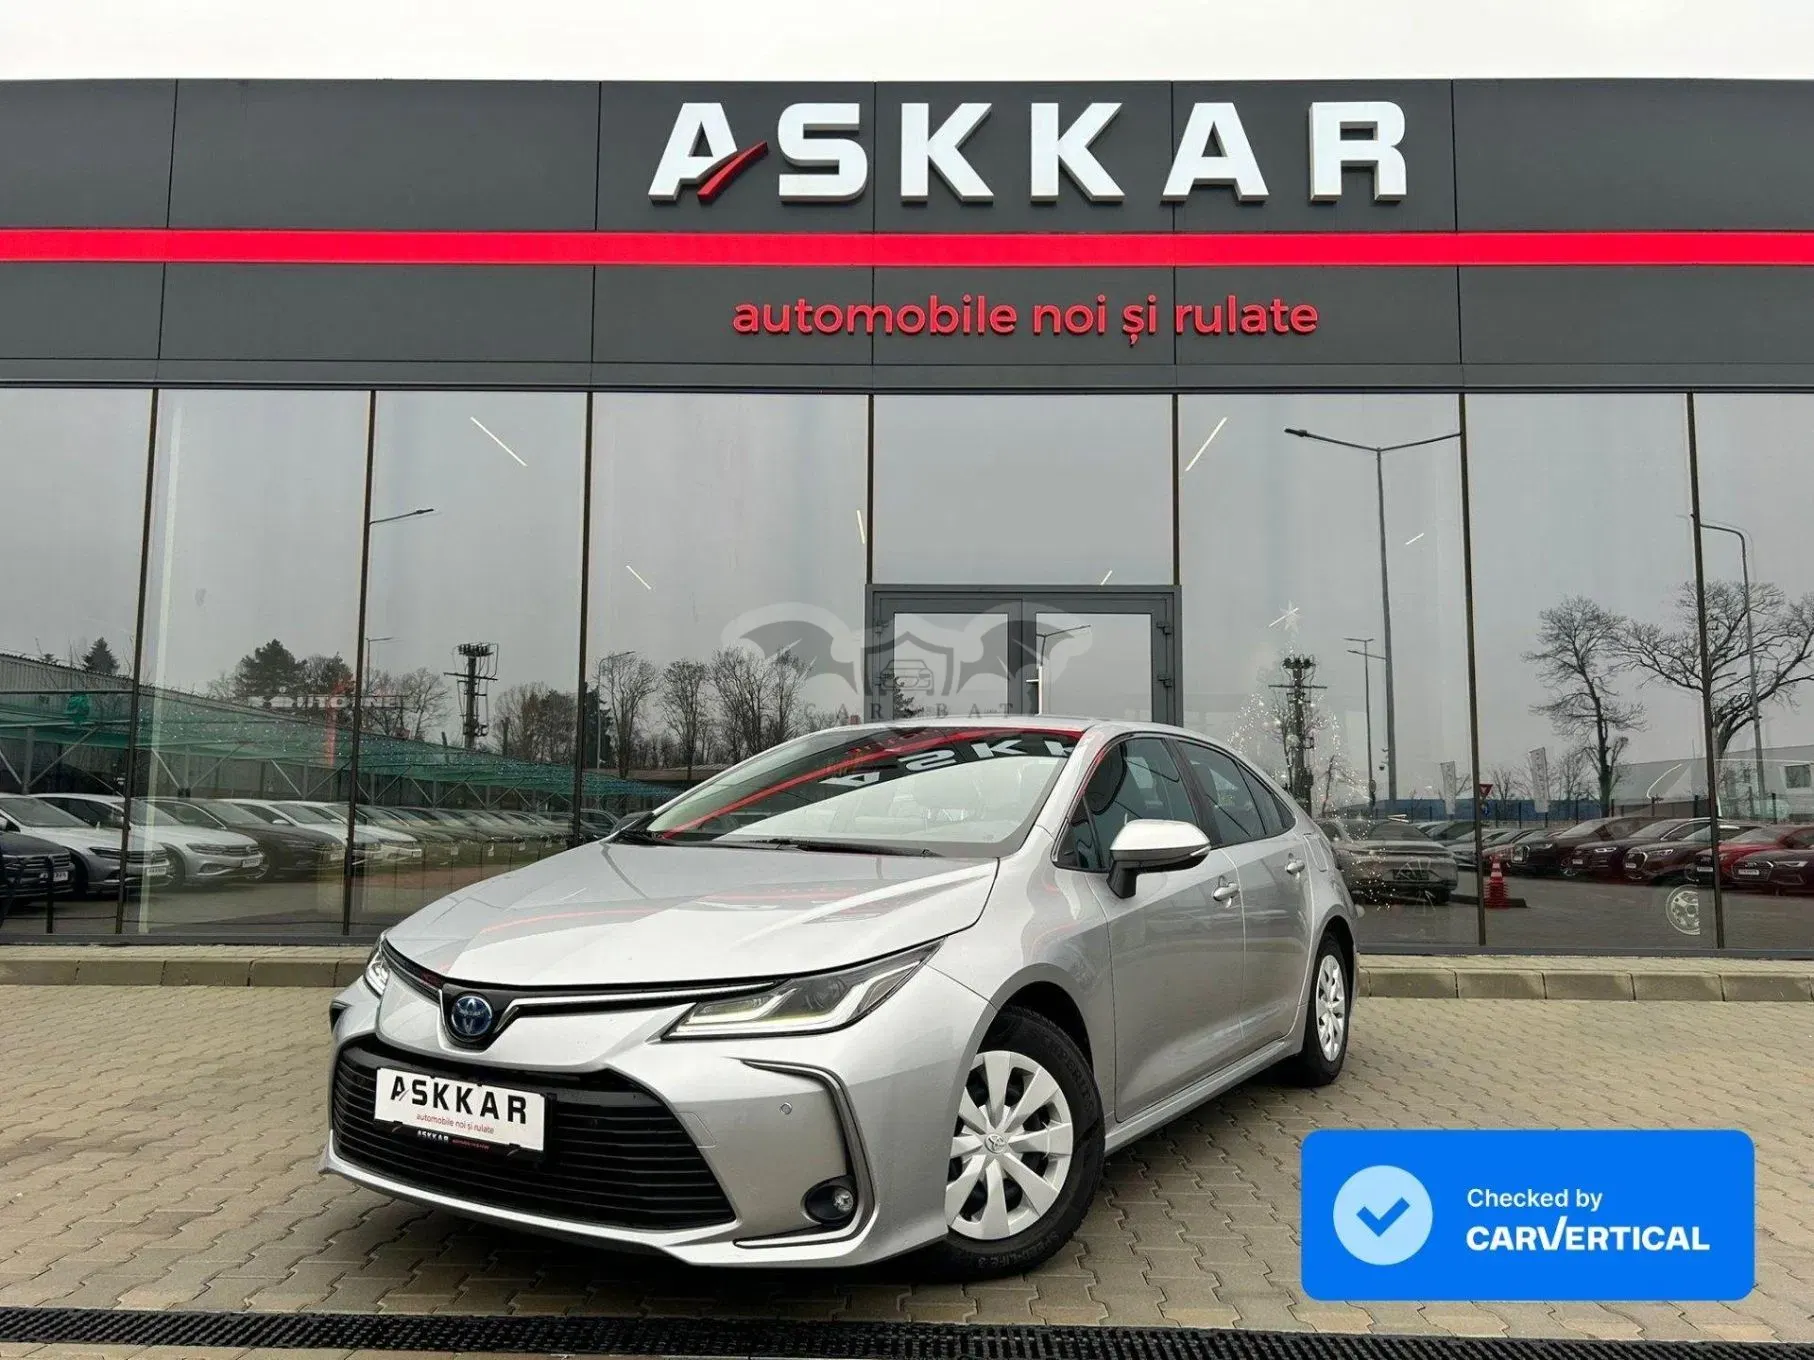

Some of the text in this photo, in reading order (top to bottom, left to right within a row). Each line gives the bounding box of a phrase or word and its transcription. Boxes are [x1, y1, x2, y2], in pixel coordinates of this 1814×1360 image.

[648, 101, 1408, 202] ASKKAR
[733, 294, 1319, 347] automobile noi și rulate
[390, 1076, 527, 1125] ASKKAR
[416, 1113, 454, 1127] automobile
[455, 1120, 466, 1129] noi
[474, 1124, 495, 1135] rulate
